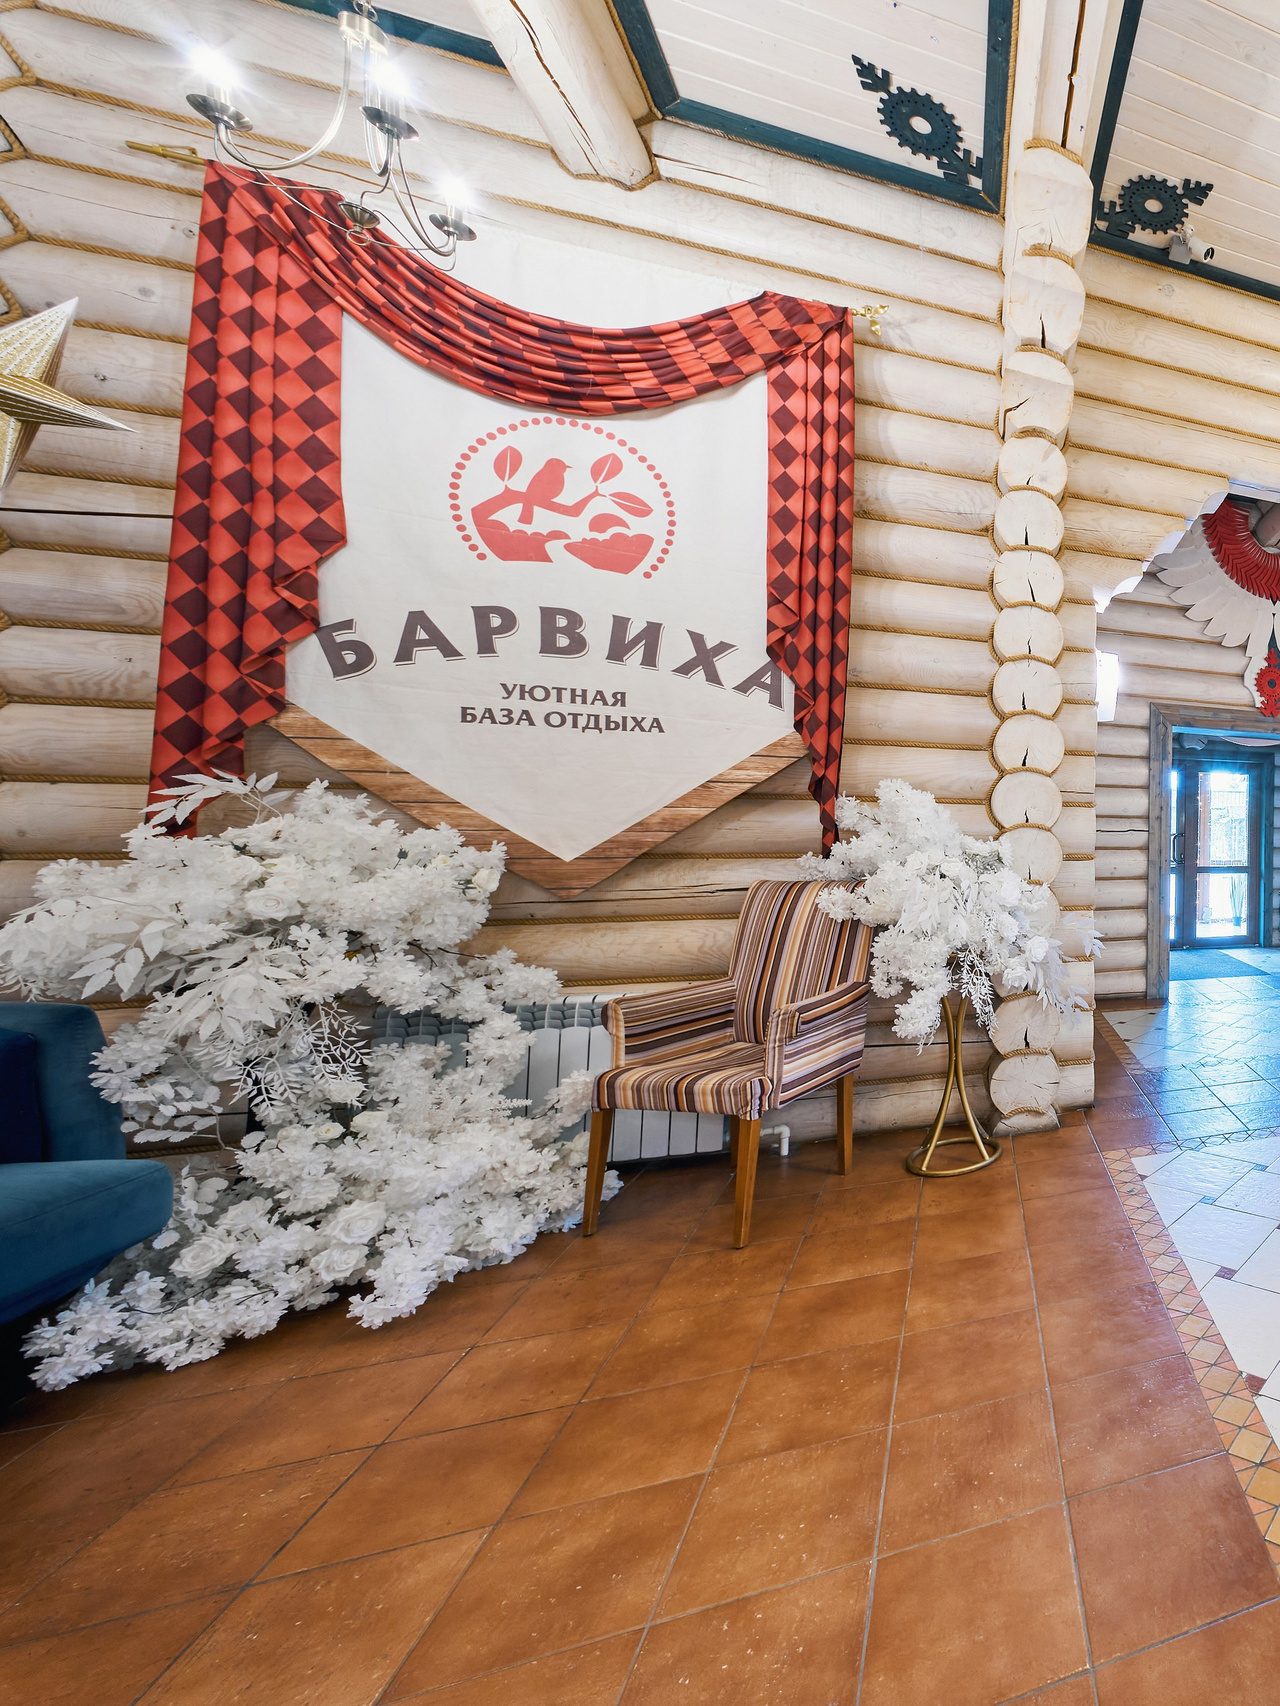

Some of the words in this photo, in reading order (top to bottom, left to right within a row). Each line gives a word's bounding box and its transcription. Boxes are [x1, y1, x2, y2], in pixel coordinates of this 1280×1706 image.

[313, 604, 786, 711] БАРВИХА
[500, 682, 628, 708] УЮТНАЯ
[460, 706, 537, 728] БАЗА
[544, 710, 666, 734] ОТДЫХА
